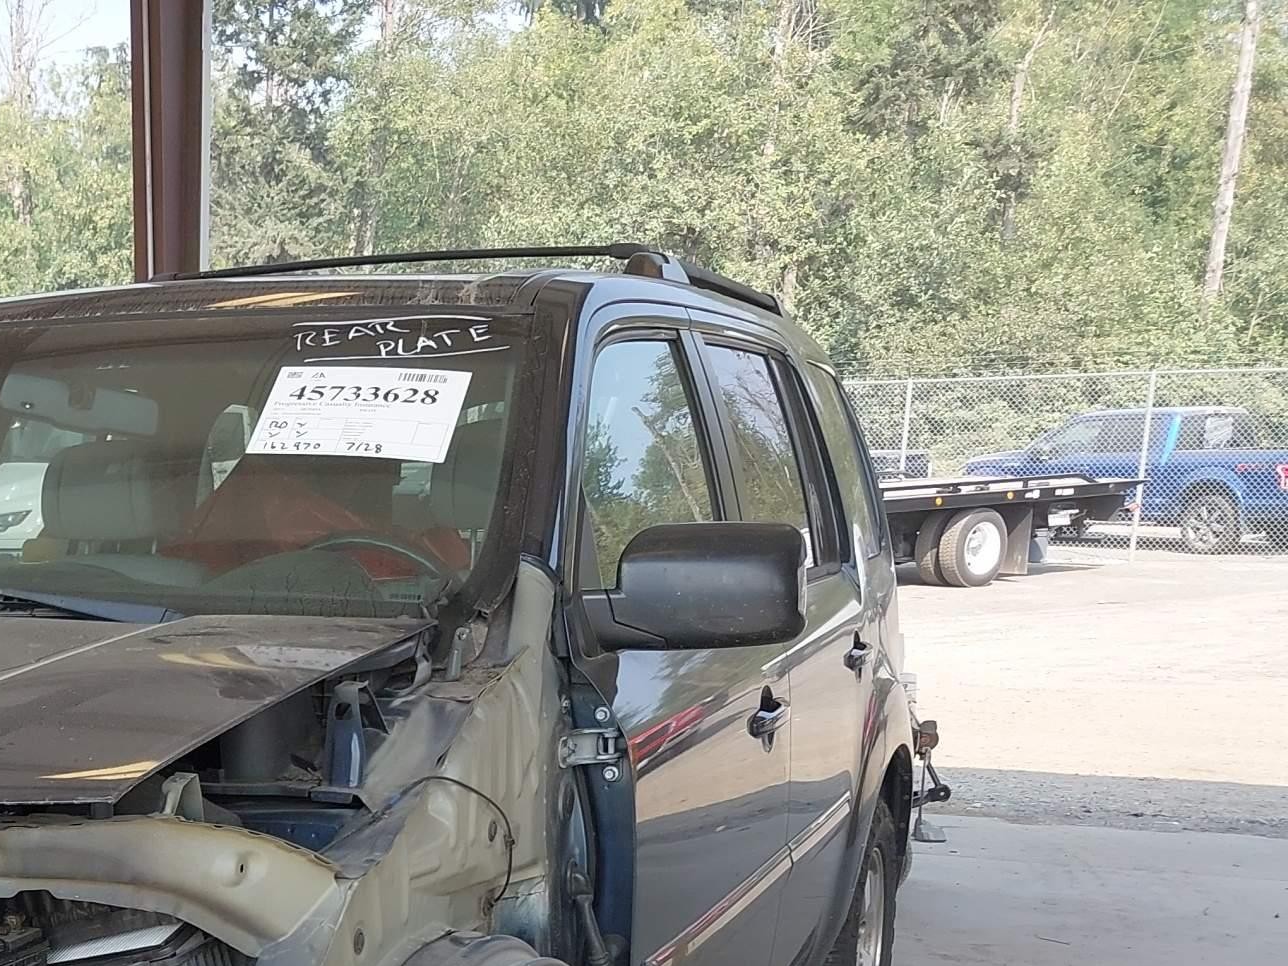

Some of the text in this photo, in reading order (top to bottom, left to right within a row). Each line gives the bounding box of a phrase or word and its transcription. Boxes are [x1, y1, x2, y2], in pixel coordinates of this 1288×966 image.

[293, 320, 411, 351] REAR
[376, 324, 493, 357] PLATE
[288, 384, 440, 406] 45733628
[345, 441, 383, 454] 7/28
